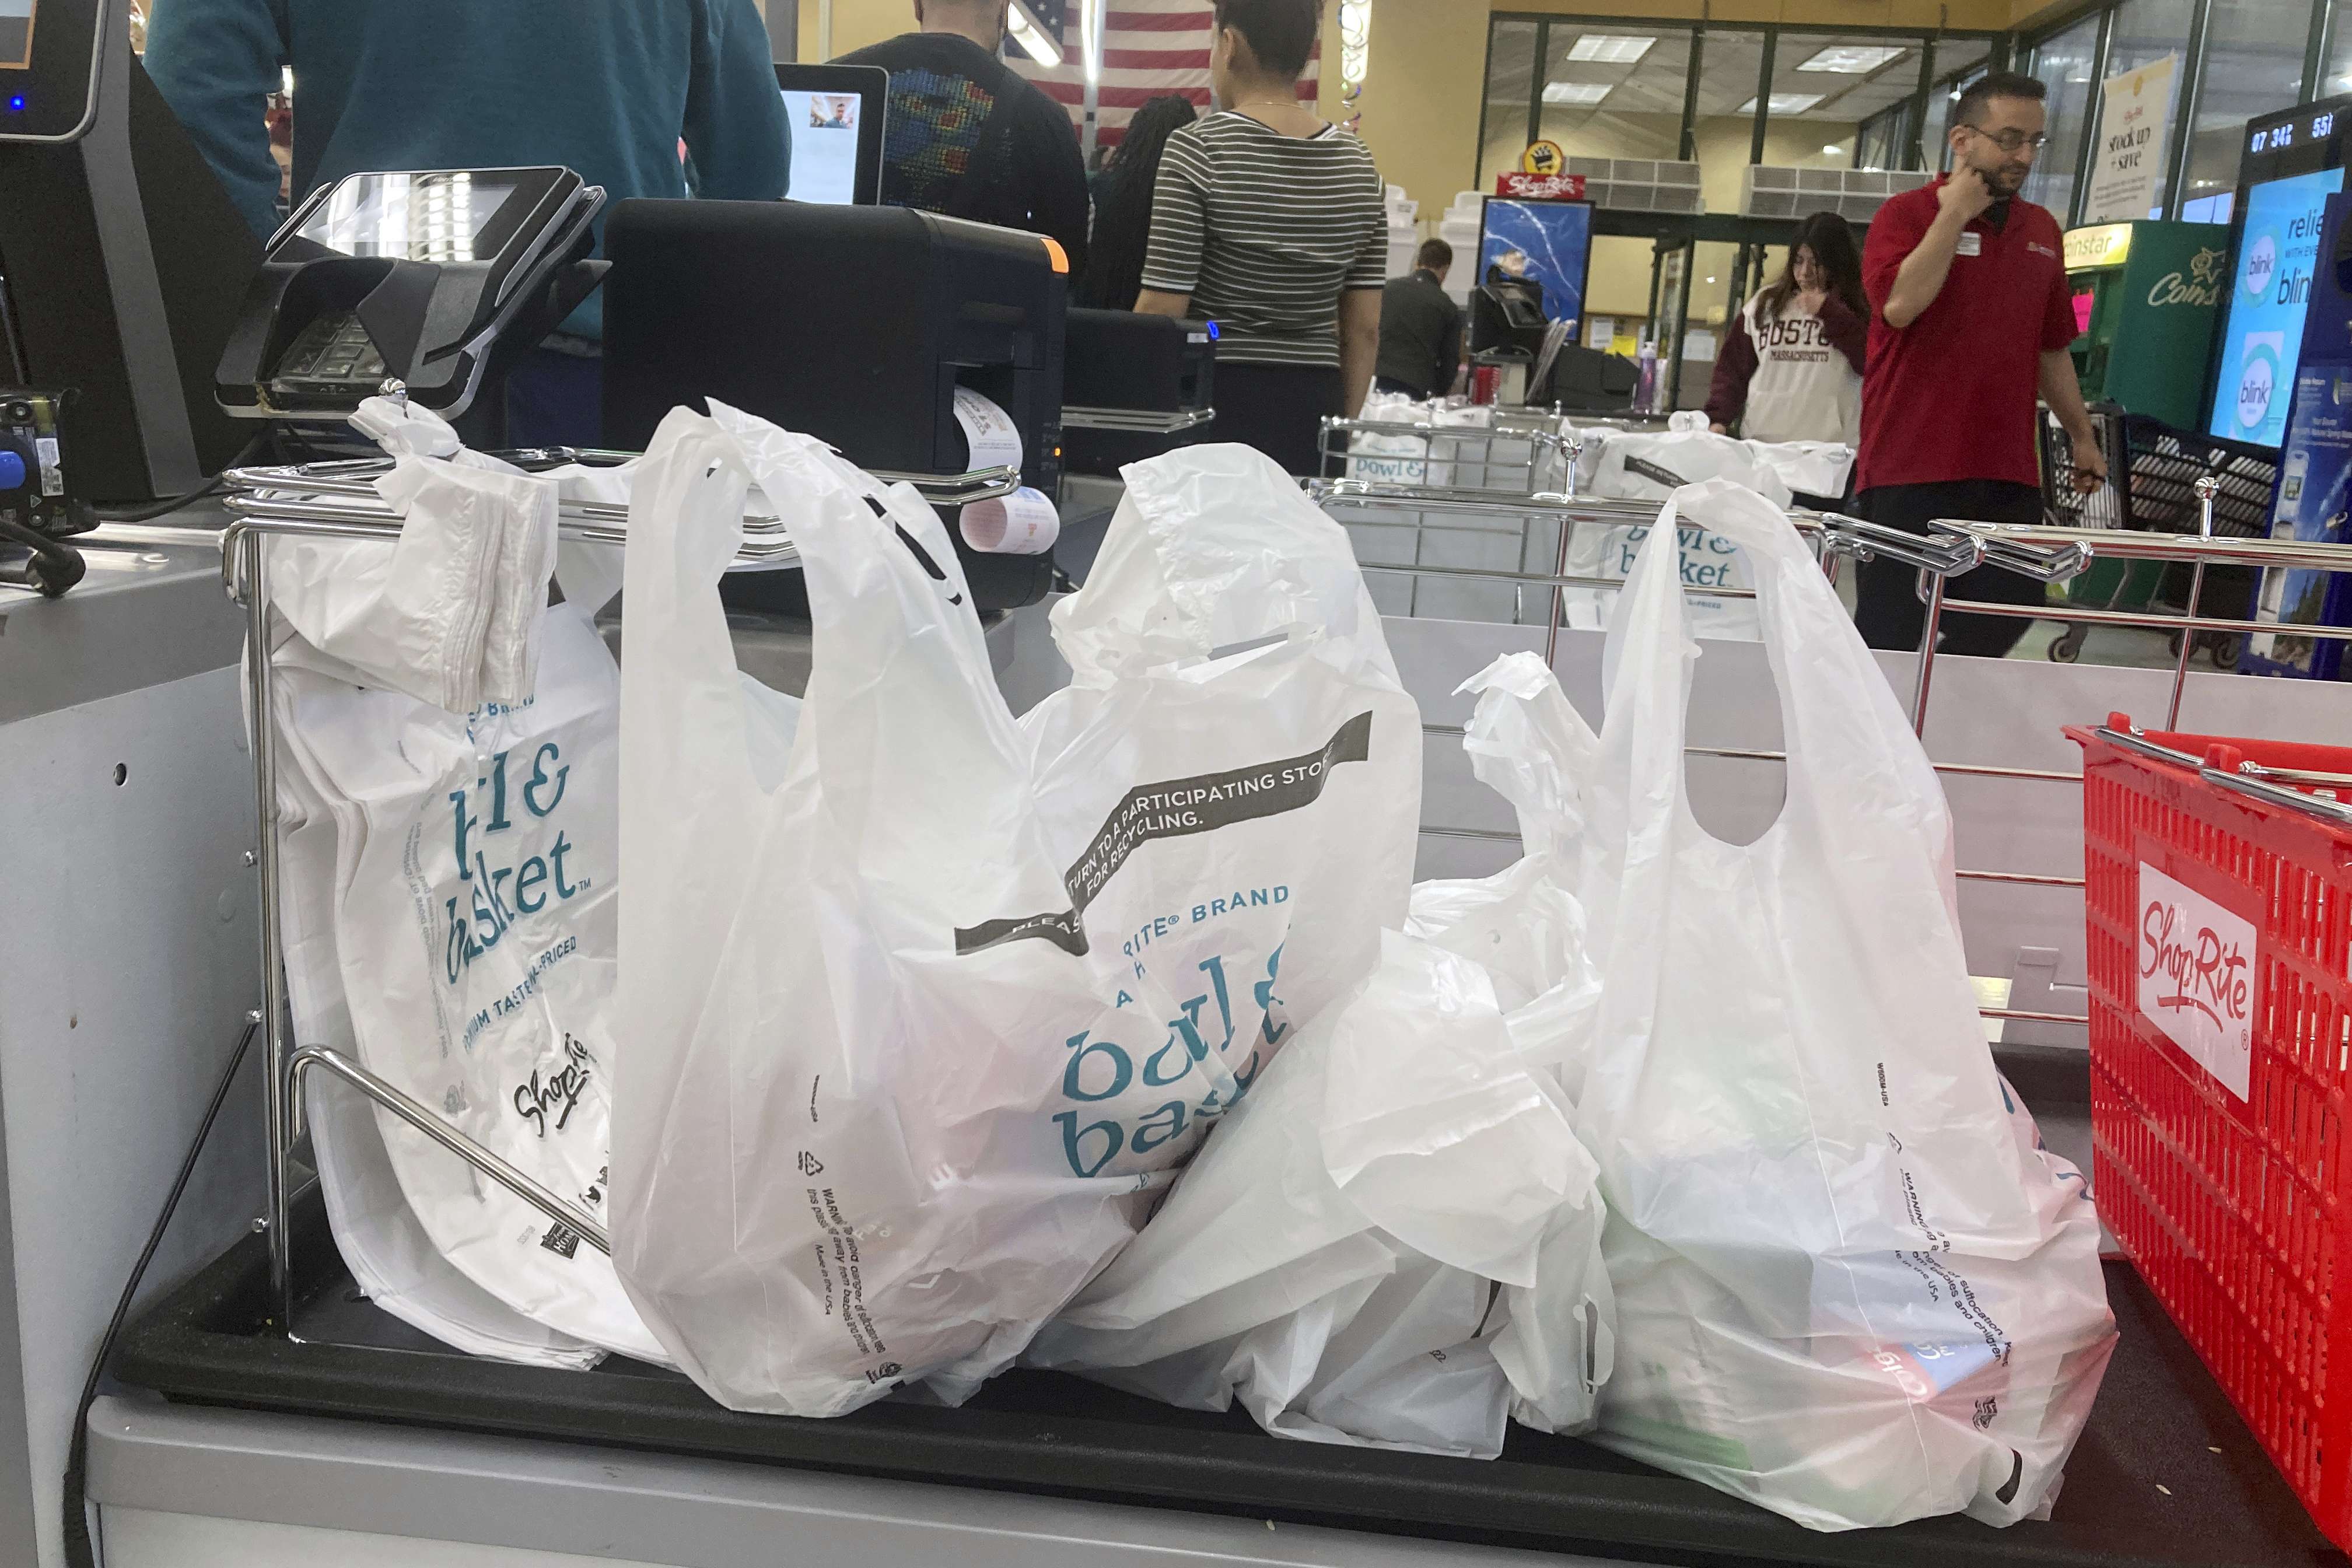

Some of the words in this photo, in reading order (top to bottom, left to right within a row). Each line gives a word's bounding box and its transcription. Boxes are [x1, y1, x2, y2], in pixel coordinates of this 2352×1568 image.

[2249, 253, 2274, 275] blink
[2277, 267, 2312, 304] blin
[2241, 380, 2270, 404] blink
[524, 743, 570, 817] &
[1013, 915, 1080, 935] PLEAS
[1068, 853, 1097, 897] TURN
[1098, 834, 1112, 858] TO
[1114, 821, 1121, 839] A
[1122, 774, 1276, 827] PARTICIPATING
[1086, 862, 1108, 897] FOR
[1111, 811, 1203, 868] RECYCLING.
[1192, 885, 1289, 923] BRAND
[2140, 901, 2247, 1026] ShopRite
[1905, 1171, 1927, 1228] WARNING
[824, 1294, 834, 1315] USA
[1927, 1279, 1941, 1302] USA
